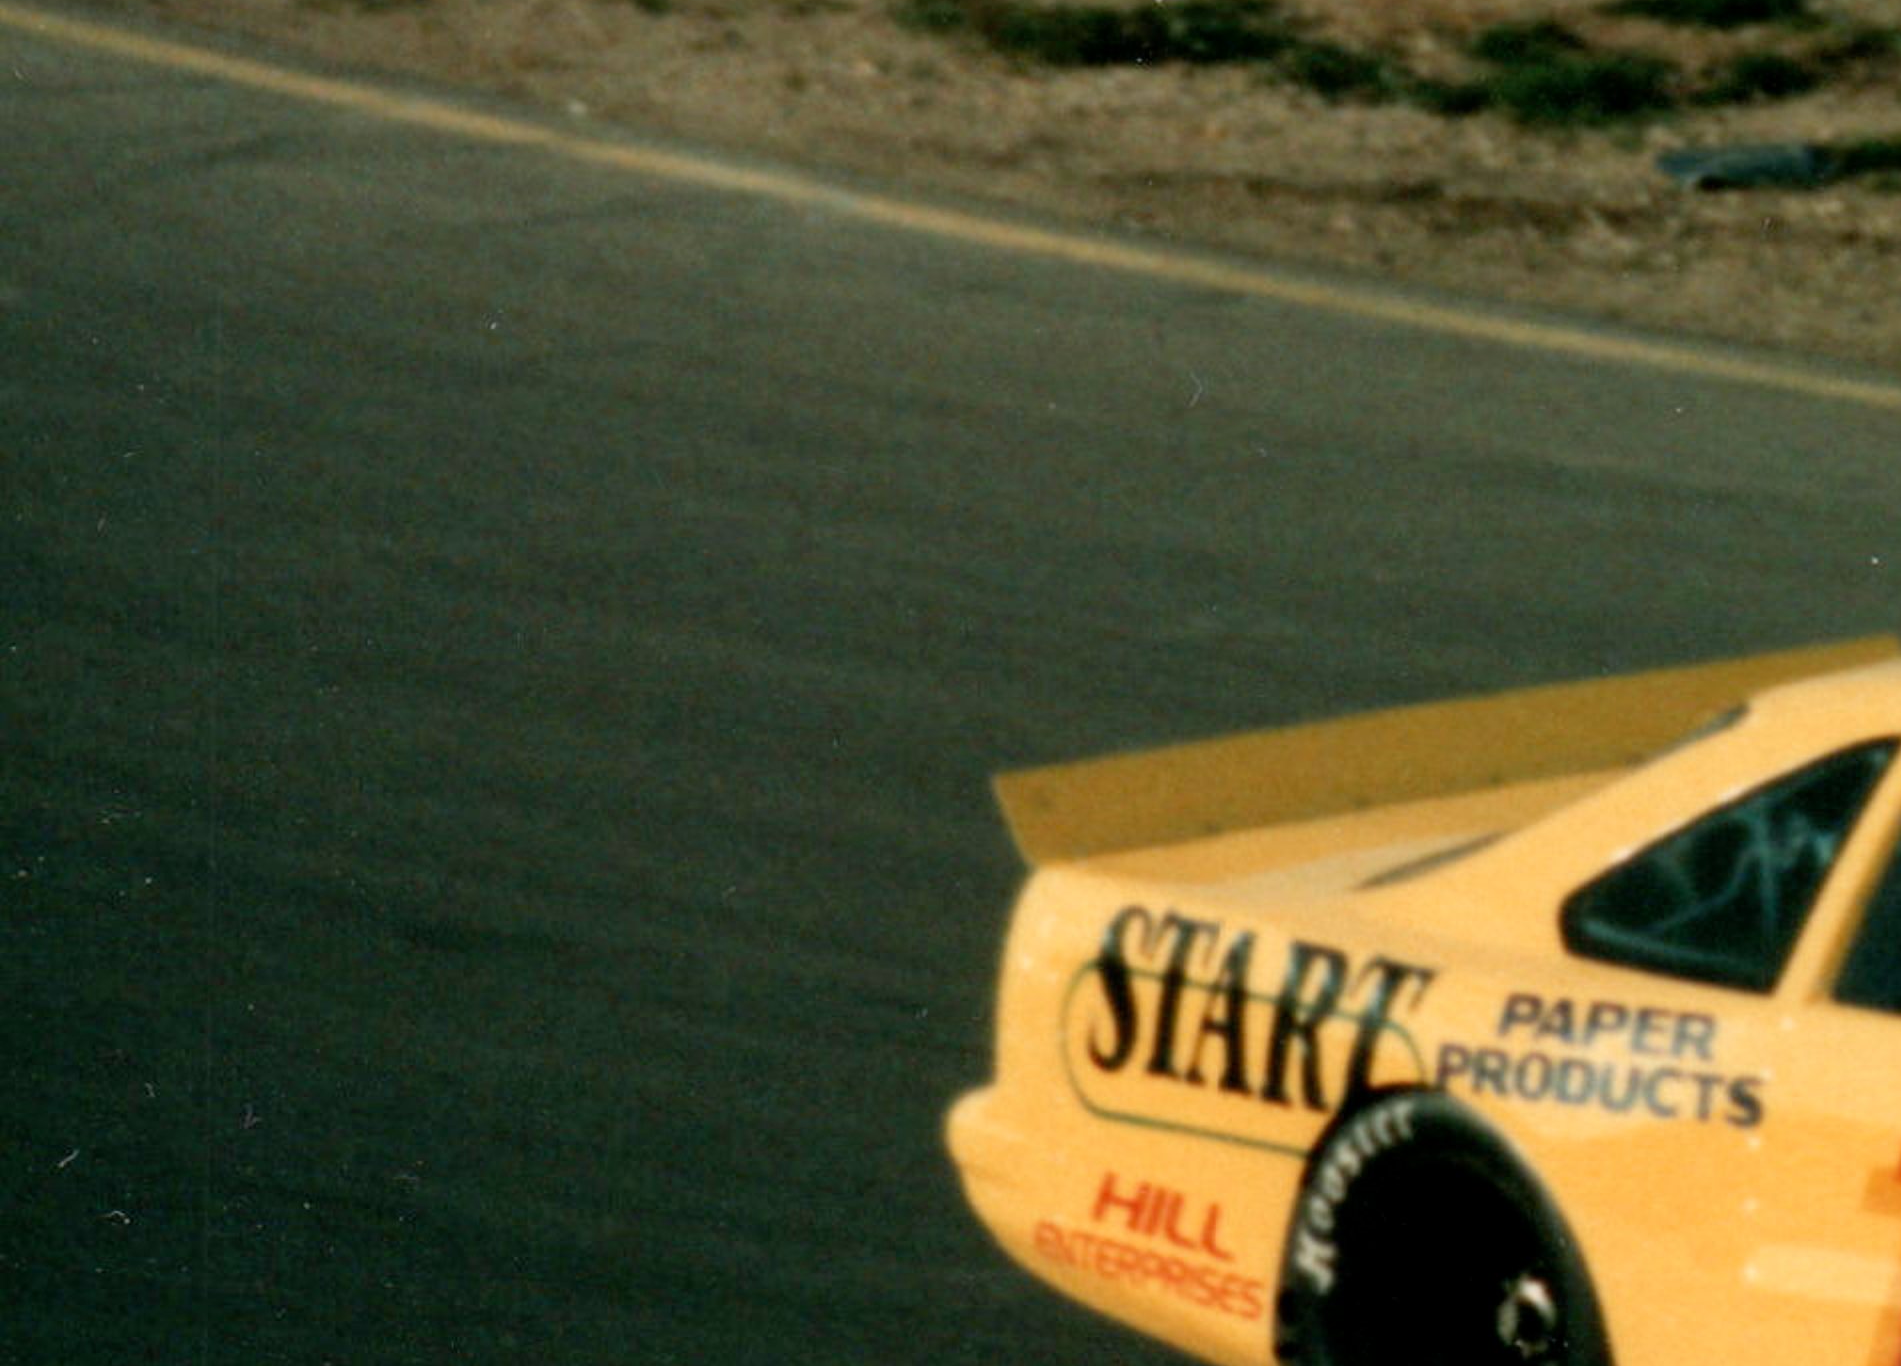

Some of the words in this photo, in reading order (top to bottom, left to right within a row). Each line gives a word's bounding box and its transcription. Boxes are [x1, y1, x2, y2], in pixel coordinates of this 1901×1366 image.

[1086, 905, 1438, 1115] START
[1498, 993, 1718, 1061] PAPER
[1435, 1043, 1765, 1129] PRODUCTS
[1091, 1170, 1236, 1263] HILL
[1033, 1219, 1265, 1322] ENTERPRISES
